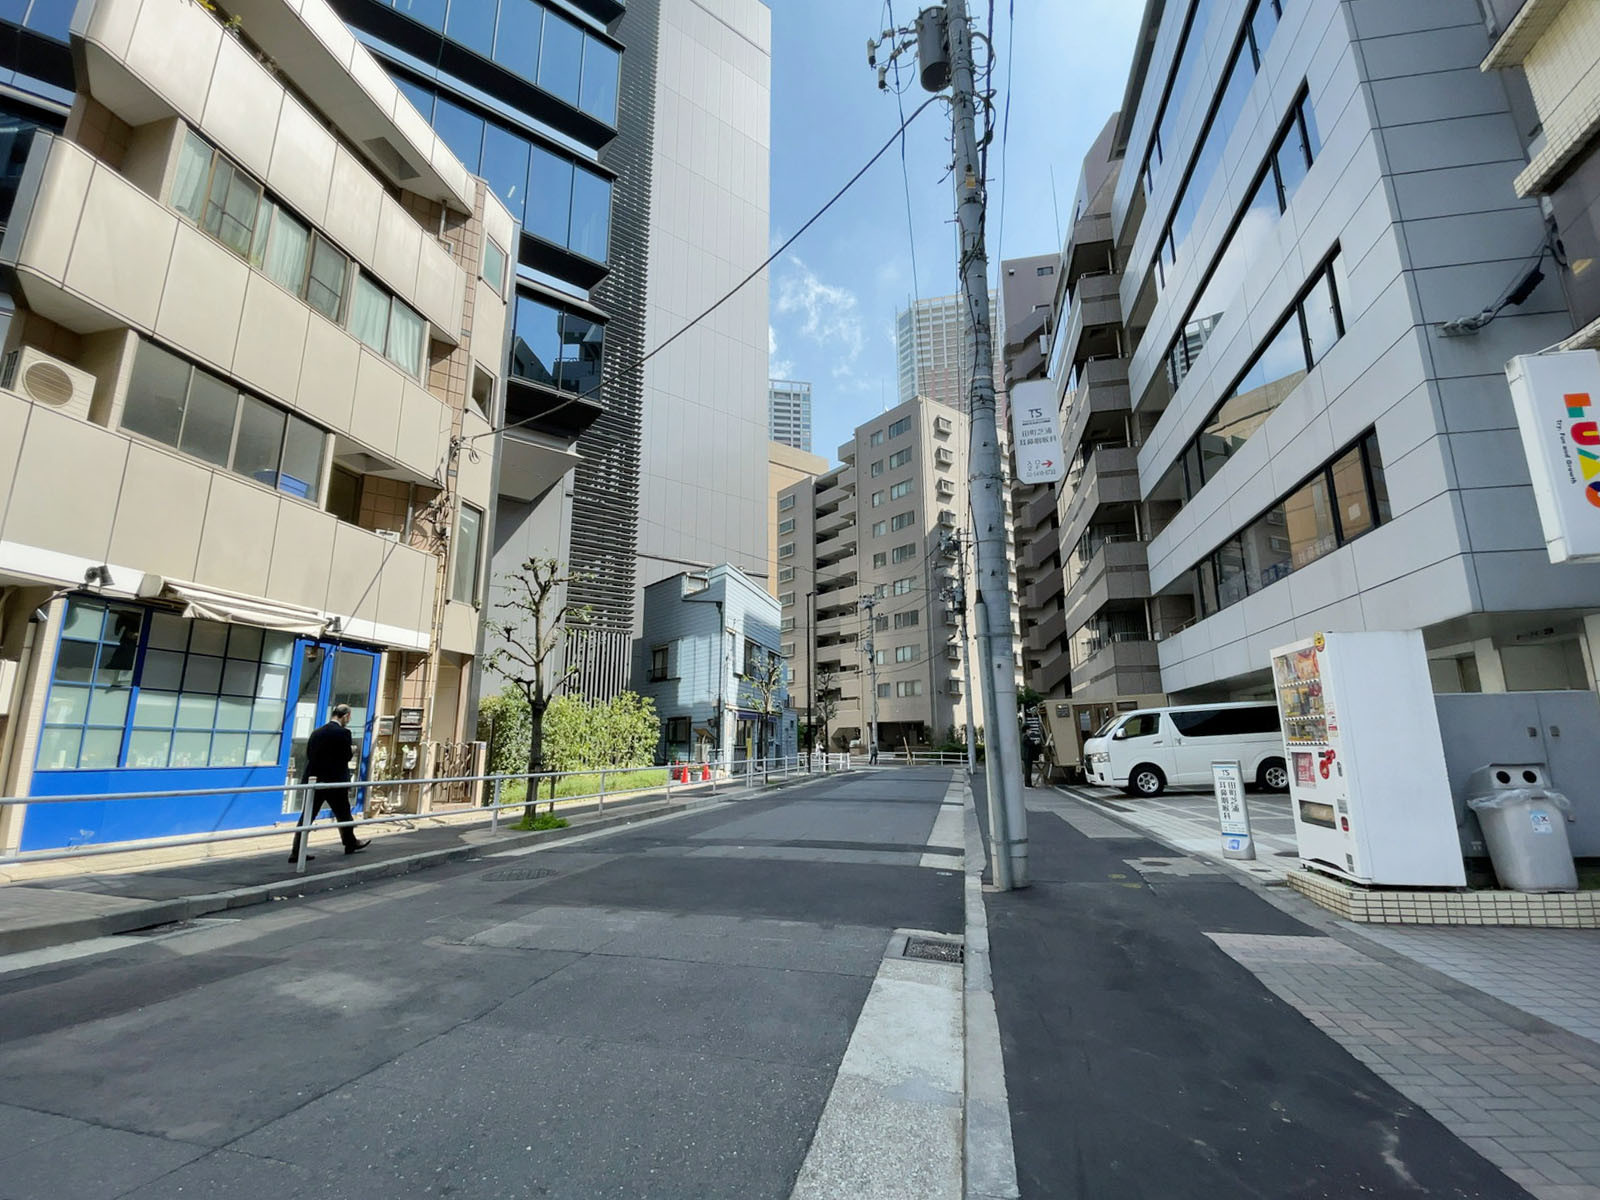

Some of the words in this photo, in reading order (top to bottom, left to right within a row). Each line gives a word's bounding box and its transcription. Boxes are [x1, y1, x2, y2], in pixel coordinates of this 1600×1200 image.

[1028, 408, 1042, 418] TS
[1562, 446, 1570, 458] and
[1565, 460, 1577, 484] Growth
